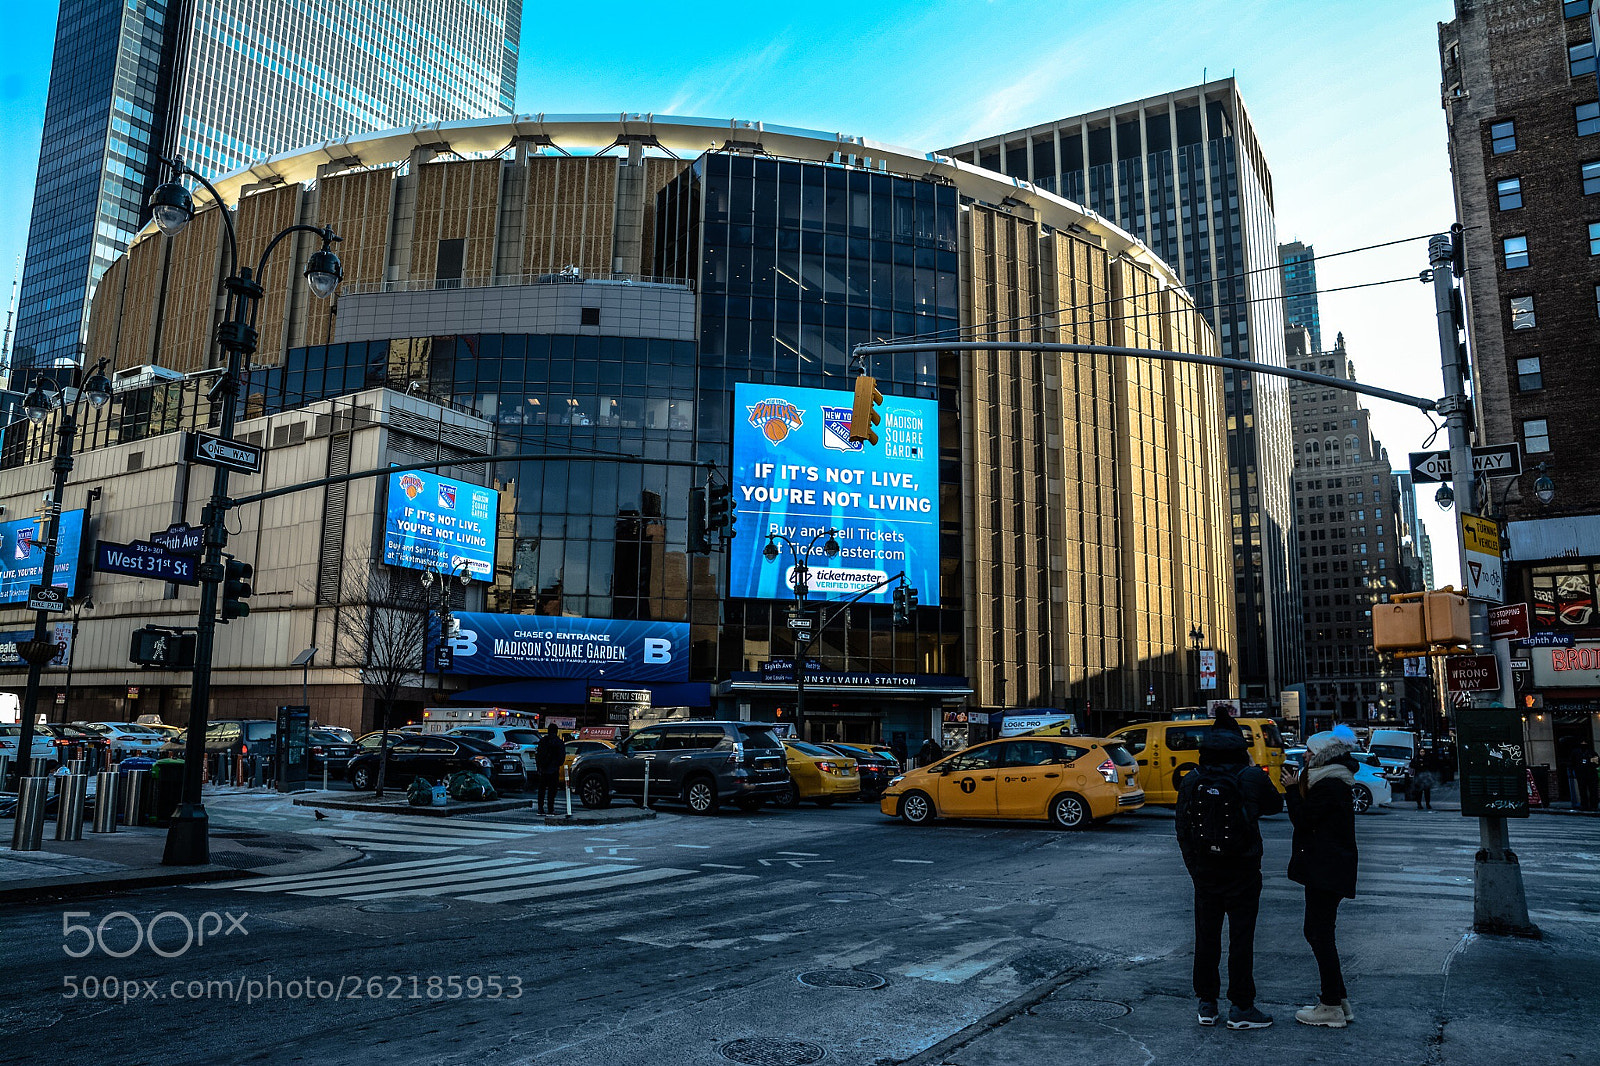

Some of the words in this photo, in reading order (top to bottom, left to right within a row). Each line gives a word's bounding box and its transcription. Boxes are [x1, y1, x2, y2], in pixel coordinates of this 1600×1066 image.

[751, 403, 800, 422] KNICKS
[825, 412, 841, 420] NEW
[885, 413, 923, 430] MADISON
[830, 422, 860, 448] RANGS
[885, 428, 923, 445] SQUARE
[208, 444, 224, 455] ONE
[233, 450, 250, 460] WAY
[1472, 454, 1504, 470] WAY
[754, 463, 774, 479] IF
[782, 465, 818, 482] IT'S
[826, 468, 864, 484] NOT
[872, 472, 919, 492] LIVE,
[741, 486, 816, 504] YOU'RE
[823, 492, 862, 508] NOT
[868, 494, 932, 513] LIVING
[404, 507, 414, 517] IF
[416, 510, 435, 522] IT'S
[438, 515, 456, 526] NOT
[459, 520, 481, 534] LIVE,
[1476, 520, 1497, 536] TURNING
[182, 534, 198, 548] Ave
[398, 520, 432, 536] YOU'RE
[436, 528, 454, 540] NOT
[456, 533, 486, 546] LIVING
[770, 523, 796, 538] Buy
[800, 526, 824, 538] and
[858, 528, 904, 543] Tickets
[388, 541, 400, 551] Buy
[788, 542, 905, 560] Ticketaster.com
[1478, 537, 1498, 550] VEHICLES
[18, 567, 37, 576] YOU'RE
[53, 563, 70, 572] IVING
[108, 550, 143, 570] West
[147, 556, 170, 572] 31st
[174, 561, 188, 576] St
[816, 570, 882, 584] ticketmaster
[1482, 572, 1489, 582] TO
[816, 581, 848, 590] VERIFIED
[1497, 607, 1520, 618] STOPPING
[448, 630, 478, 656] B
[514, 630, 544, 639] CHASE
[556, 632, 610, 642] ENTRANCE
[494, 639, 541, 656] MADISON
[544, 642, 583, 659] SQUARE
[1522, 637, 1550, 646] Eighth
[644, 638, 672, 664] B
[804, 675, 870, 684] NNSYLVANIA
[875, 678, 916, 686] STATION
[1452, 668, 1488, 680] WRONG
[1459, 680, 1481, 688] WAY
[612, 692, 630, 700] PENN
[964, 780, 972, 792] T
